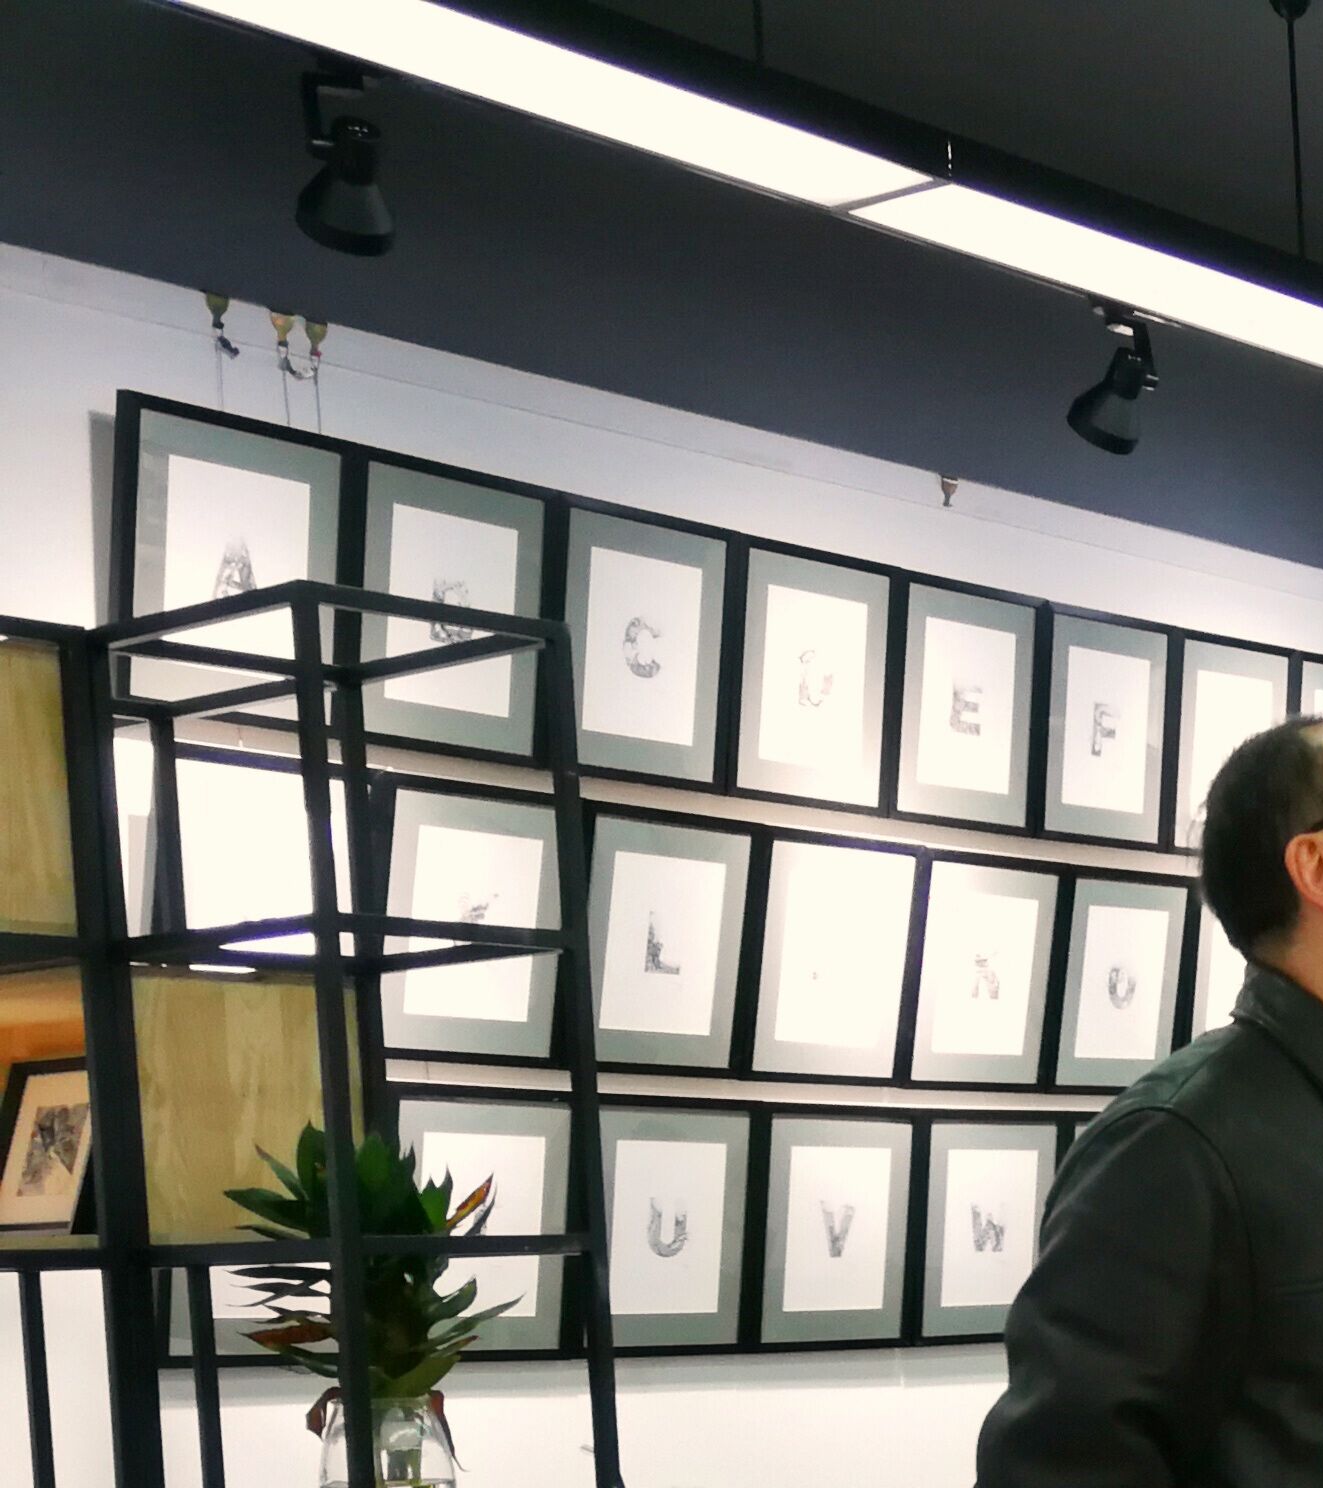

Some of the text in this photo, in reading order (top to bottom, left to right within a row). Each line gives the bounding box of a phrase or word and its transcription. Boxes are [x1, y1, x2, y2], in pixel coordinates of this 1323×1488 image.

[213, 536, 257, 601] A
[623, 615, 662, 680] C
[950, 681, 984, 737] E
[1091, 699, 1119, 757] F
[644, 908, 681, 976] L
[1107, 963, 1136, 1010] O
[647, 1195, 689, 1258] U
[820, 1199, 856, 1258] V
[970, 1201, 1006, 1253] W
